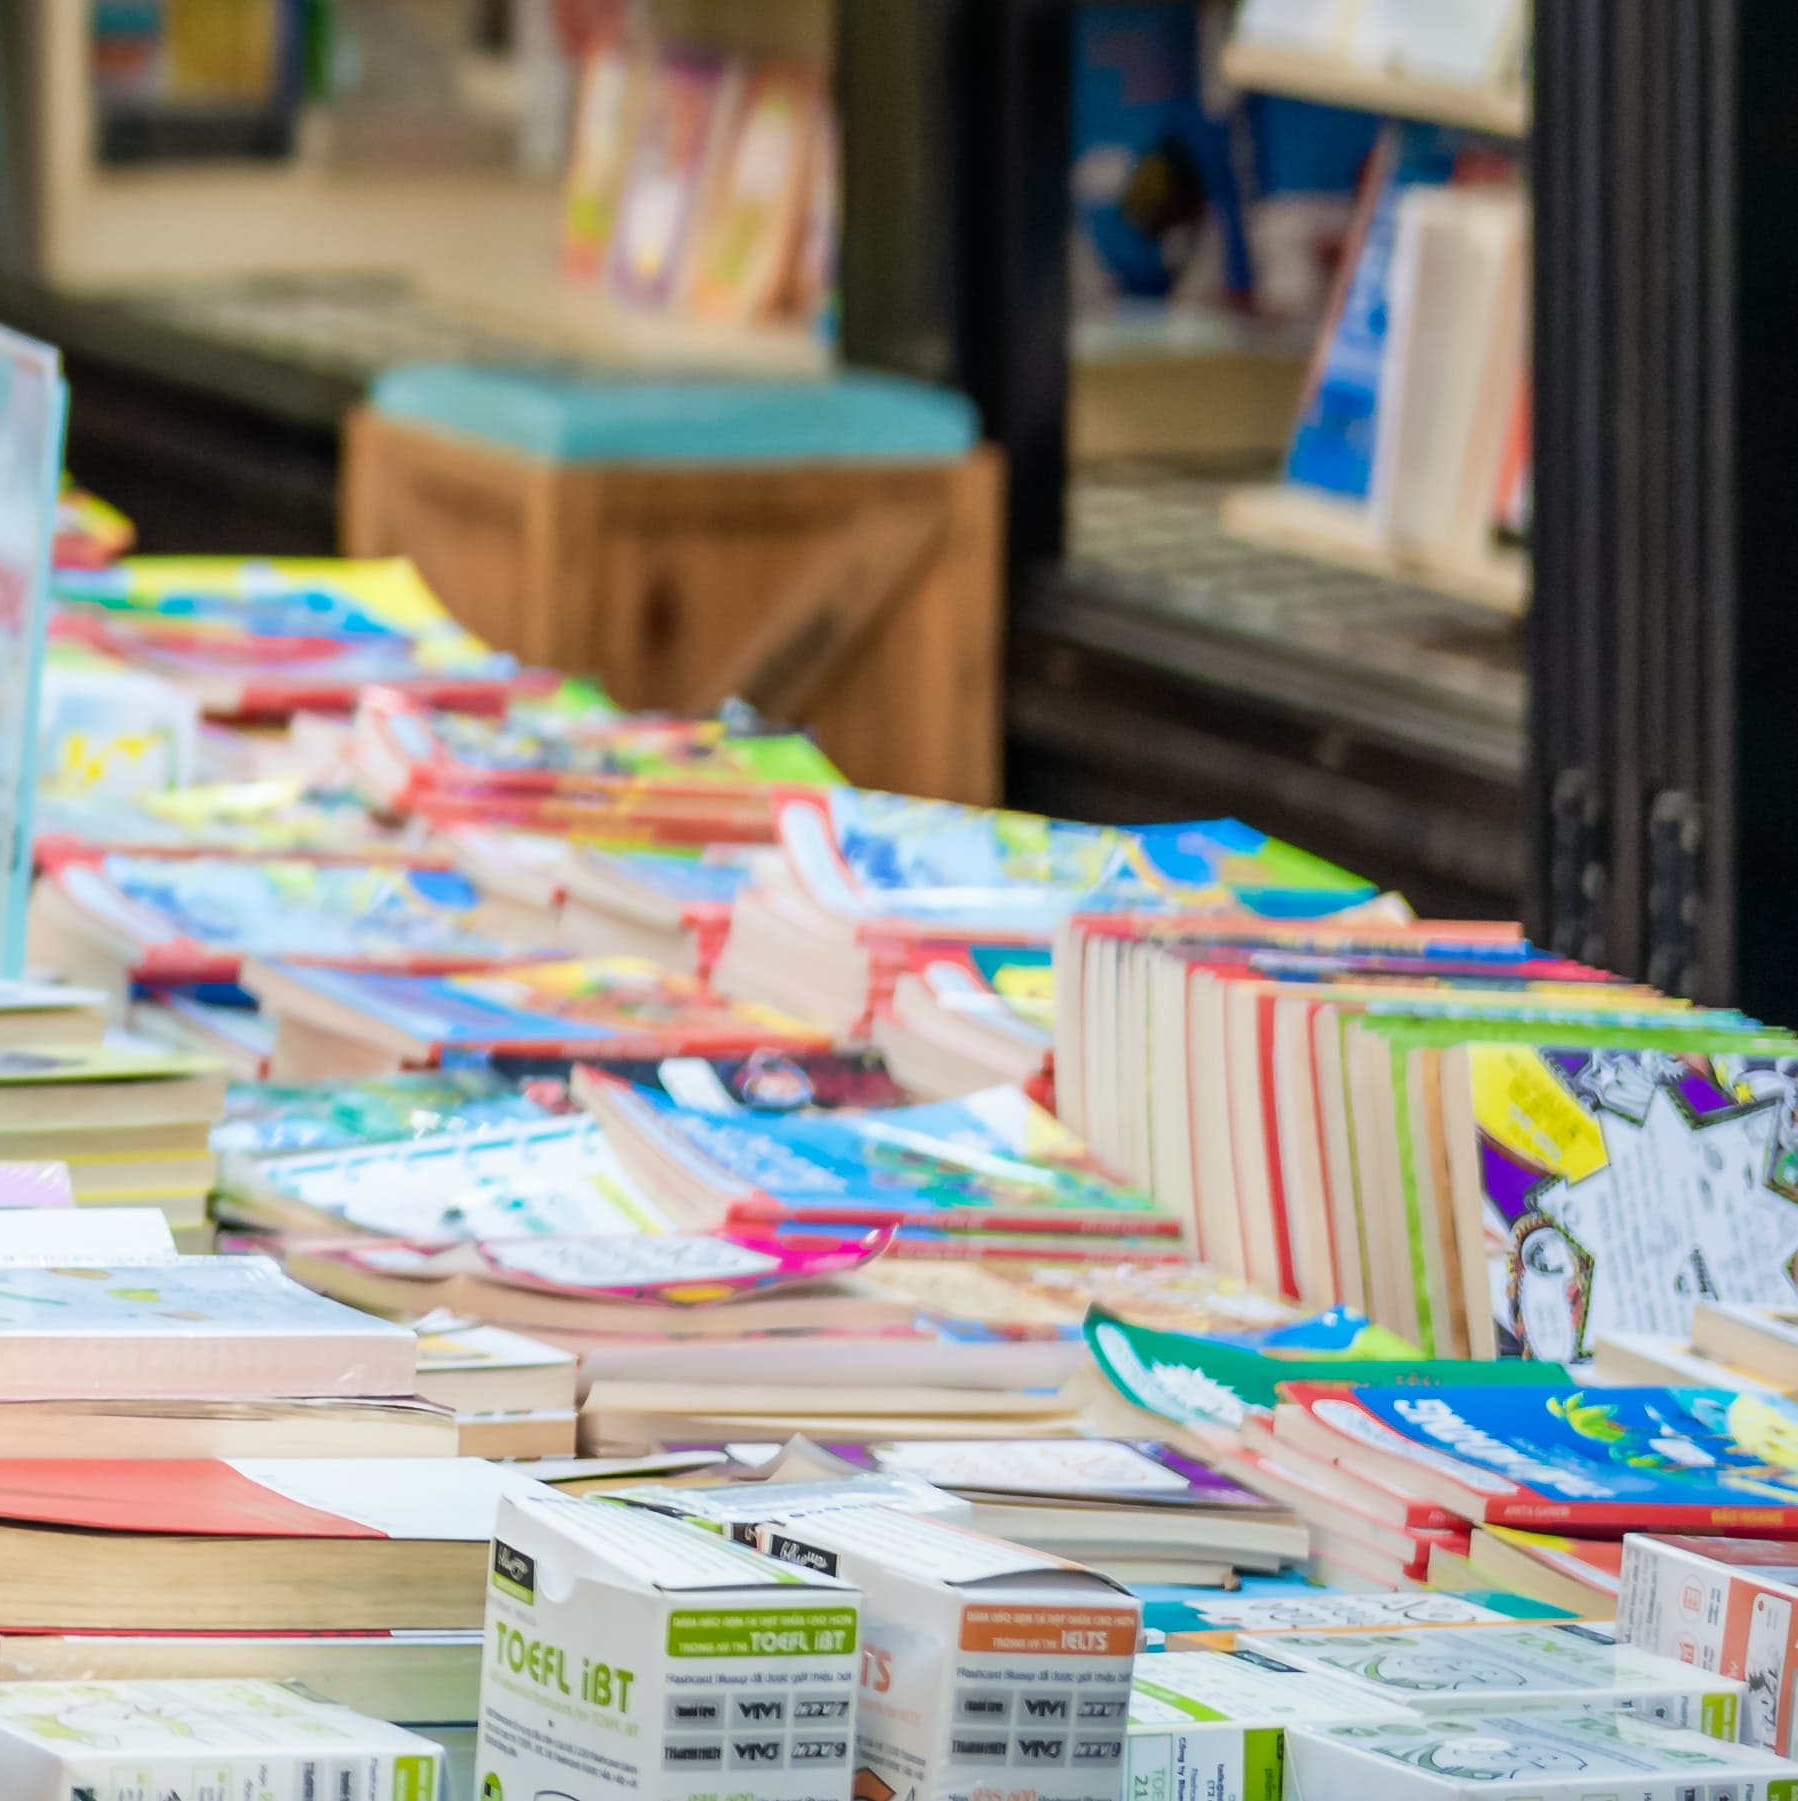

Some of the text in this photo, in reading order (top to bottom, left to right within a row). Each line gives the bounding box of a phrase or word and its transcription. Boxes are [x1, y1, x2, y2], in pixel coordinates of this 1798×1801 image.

[750, 1631, 808, 1652] TOEFL
[1060, 1630, 1109, 1650] IELTS
[496, 1621, 570, 1696] TOEFL
[581, 1657, 634, 1714] iBT
[737, 1702, 782, 1720] VTV1
[1024, 1699, 1066, 1717] VTV1
